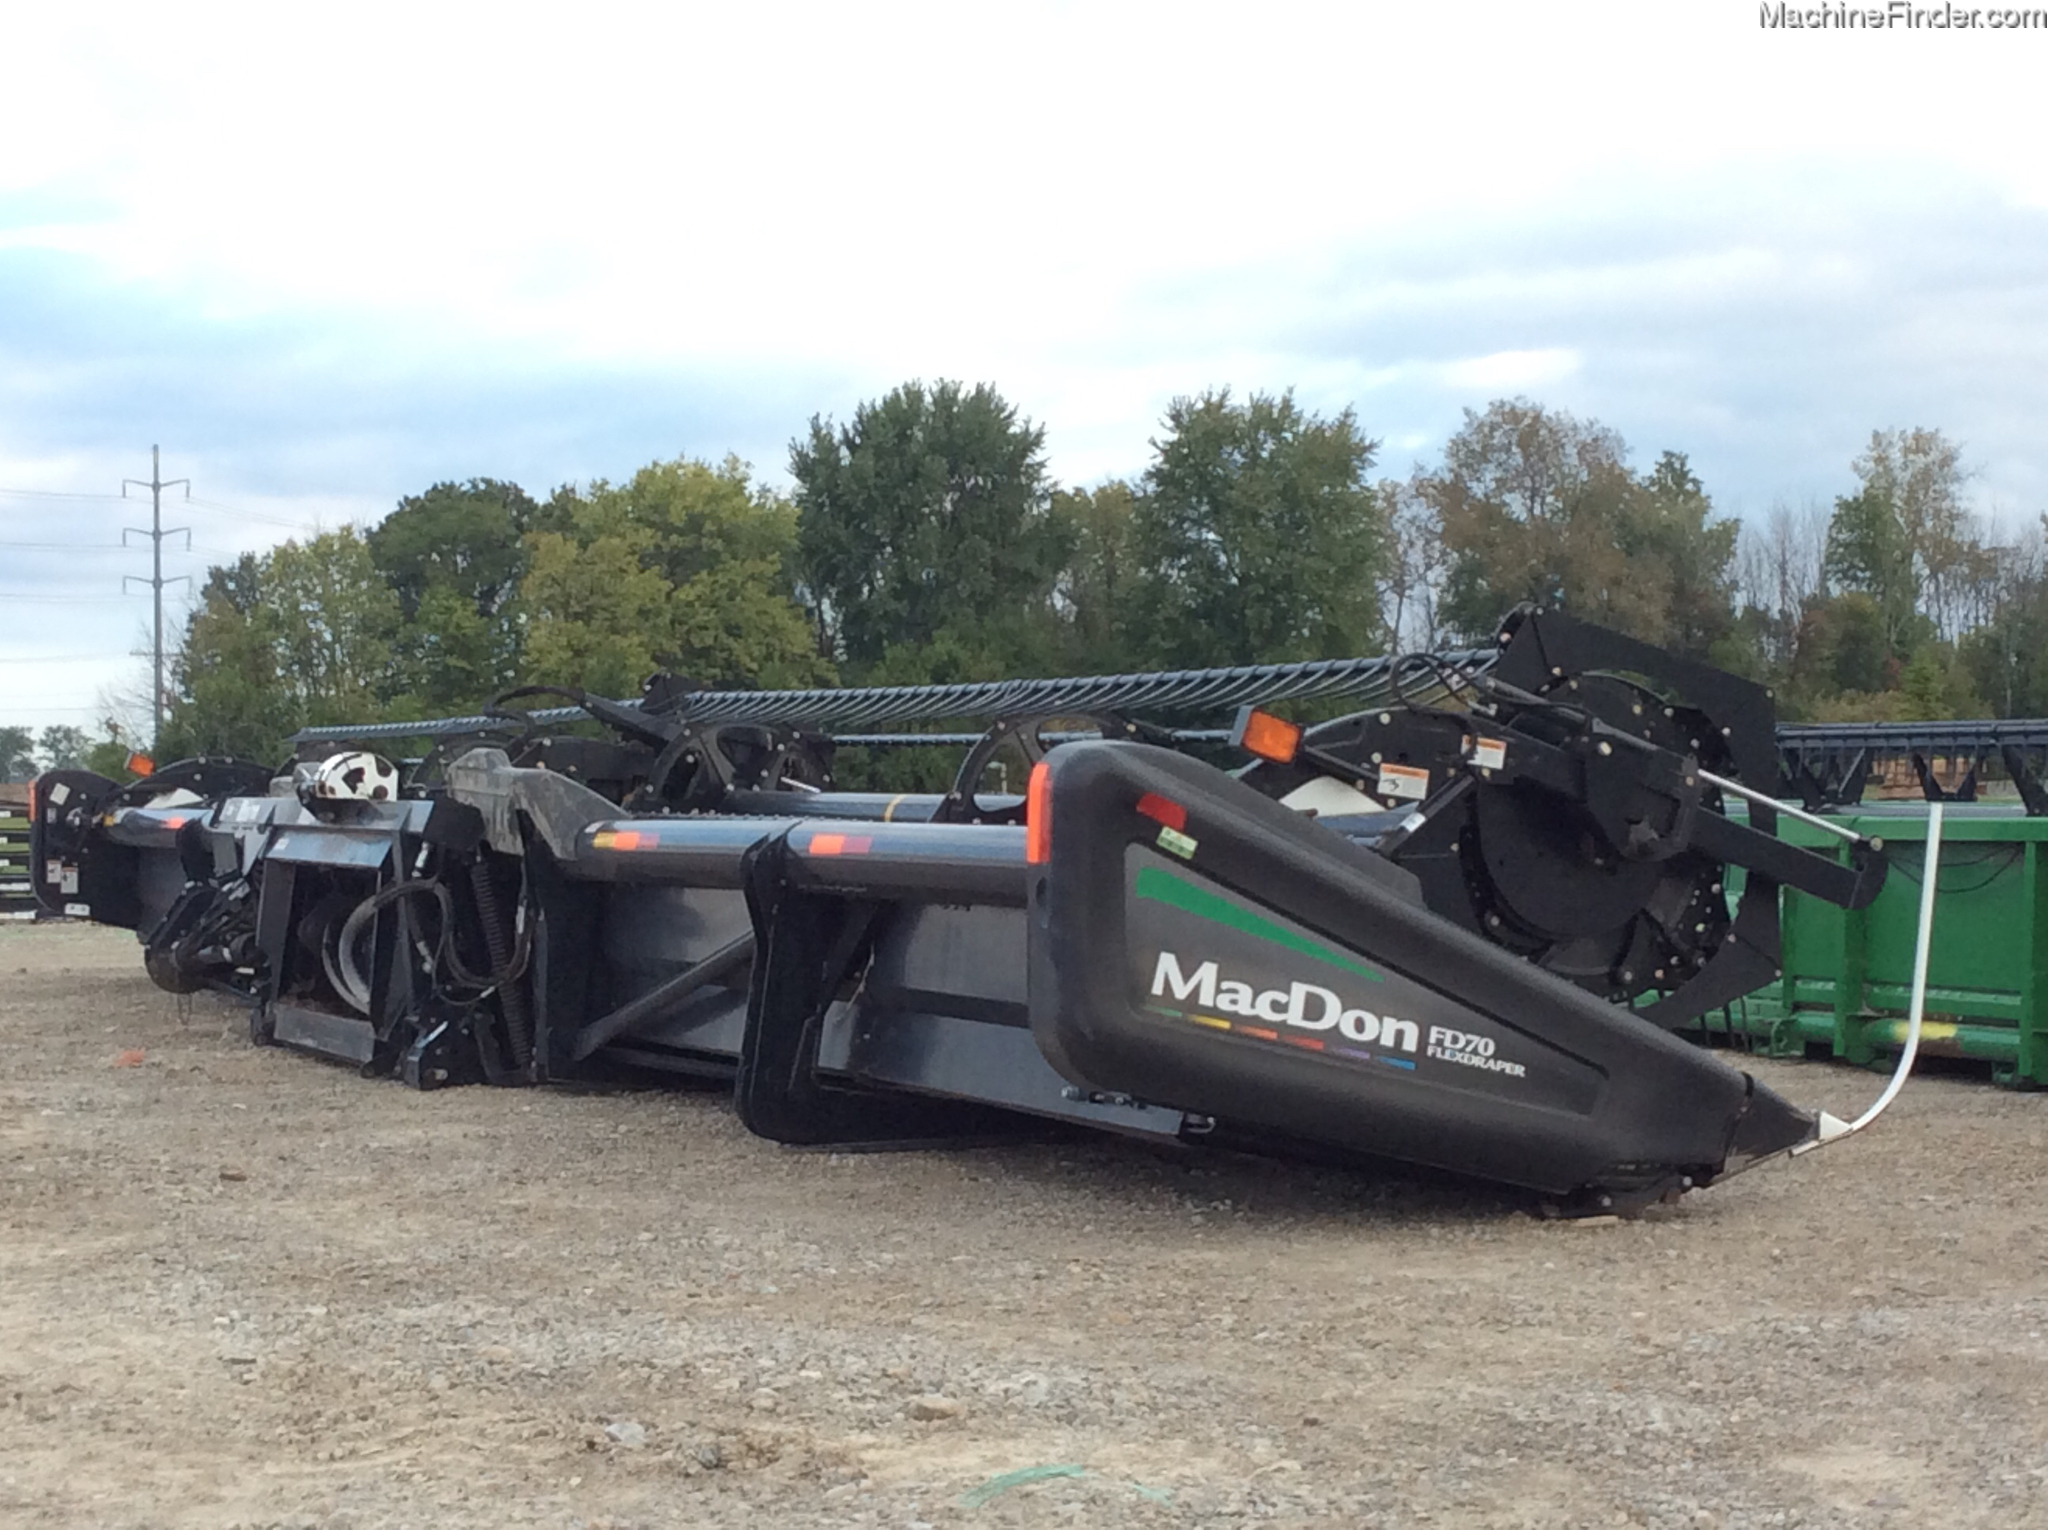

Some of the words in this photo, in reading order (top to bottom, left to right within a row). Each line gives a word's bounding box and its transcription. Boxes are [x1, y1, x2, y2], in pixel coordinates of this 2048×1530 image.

[1150, 951, 1420, 1053] MacDon
[1428, 1025, 1496, 1057] FD70
[1426, 1044, 1526, 1078] FLEXDRAPER
